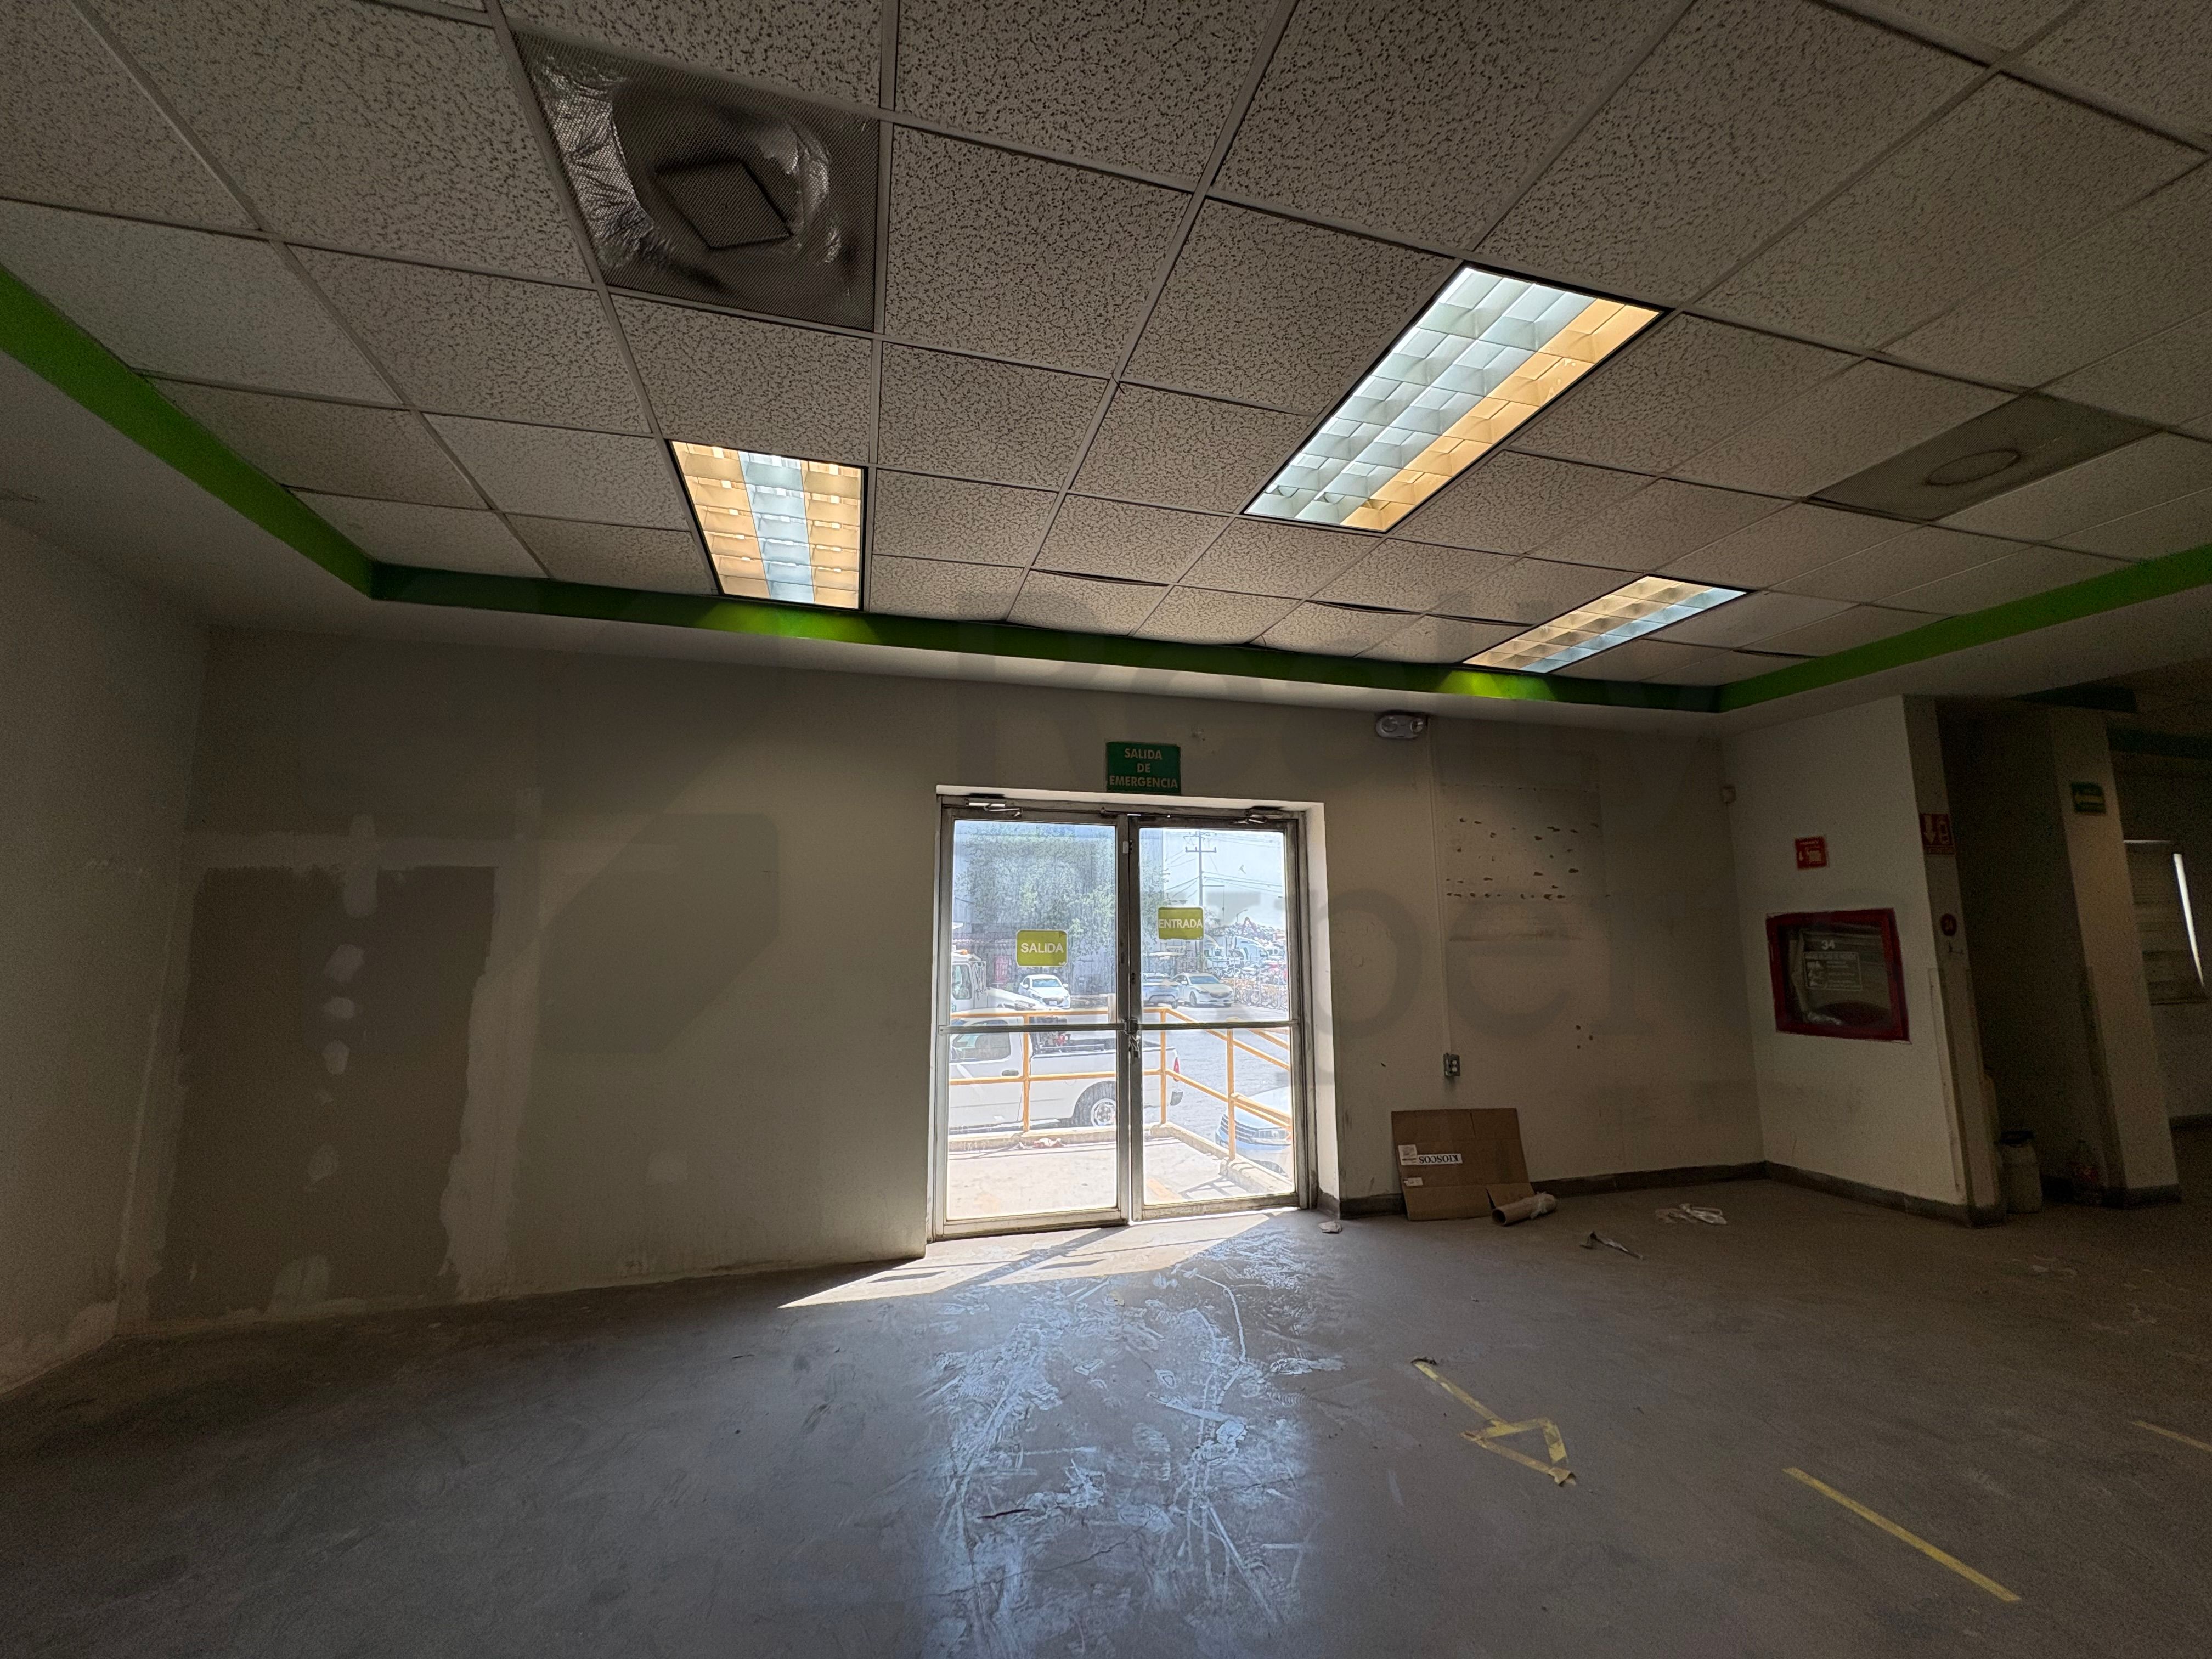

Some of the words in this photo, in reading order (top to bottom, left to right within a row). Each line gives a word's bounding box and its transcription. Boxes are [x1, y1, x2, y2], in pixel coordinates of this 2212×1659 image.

[1124, 748, 1163, 760] SALIDA
[1137, 763, 1150, 774] DE
[1109, 775, 1178, 788] EMERGENCIA
[1159, 918, 1203, 929] ENTRADA
[1020, 942, 1064, 953] SALIDA
[1821, 939, 1835, 950] 34
[1418, 1154, 1459, 1164] KIOSCOS
